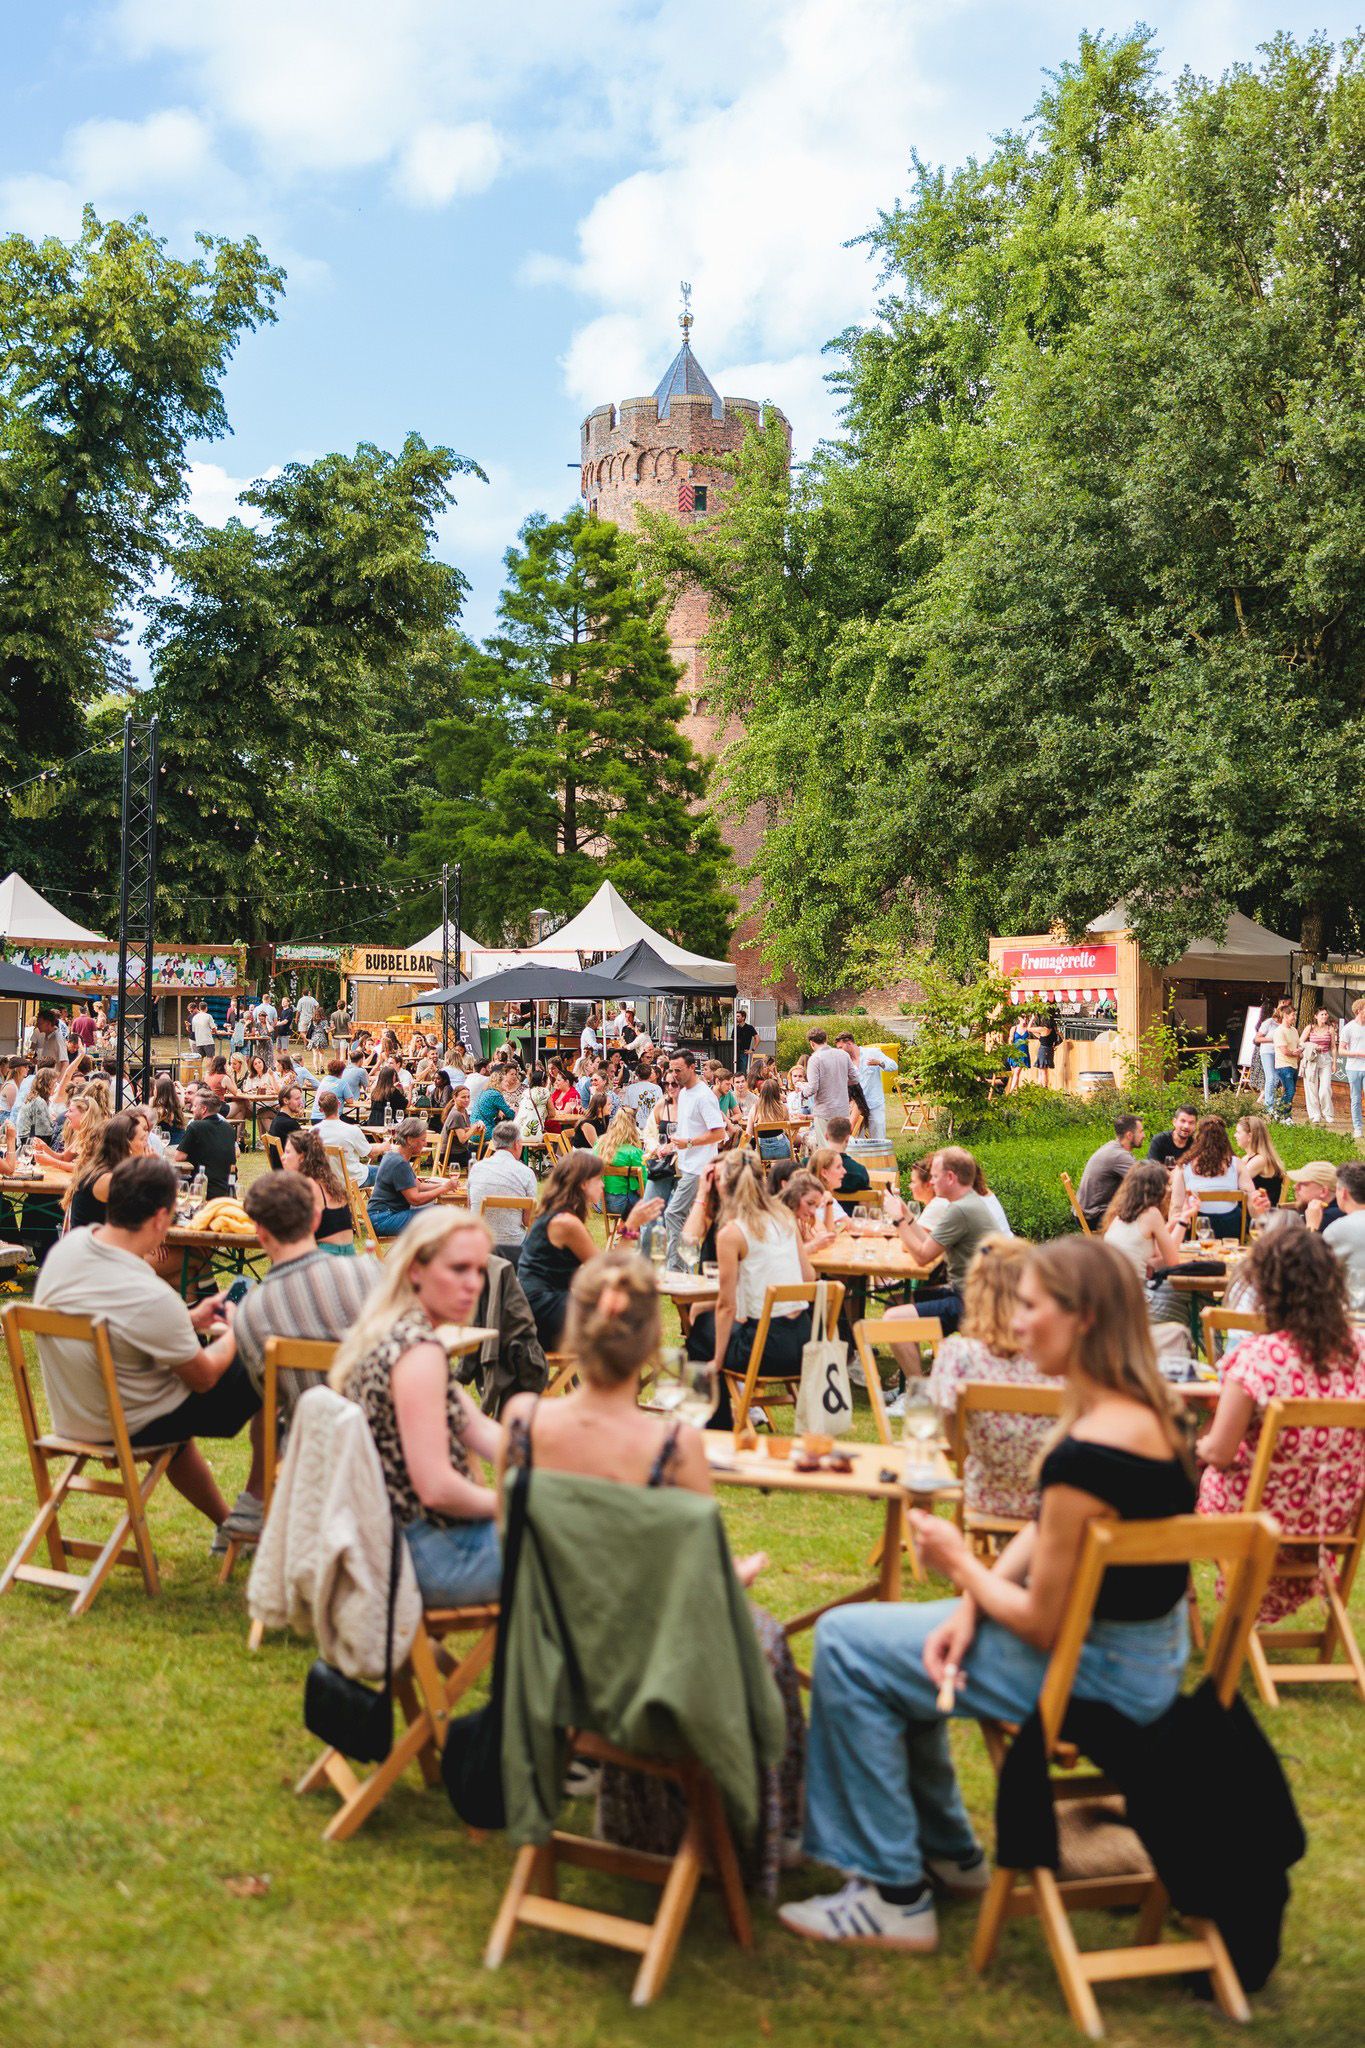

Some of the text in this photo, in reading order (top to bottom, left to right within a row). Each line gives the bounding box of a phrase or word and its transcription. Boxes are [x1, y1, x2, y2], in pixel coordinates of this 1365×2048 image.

[366, 953, 433, 972] BUBBELBAR
[1021, 951, 1096, 974] Fromagerette
[1321, 963, 1329, 973] DE
[823, 1363, 849, 1414] &
